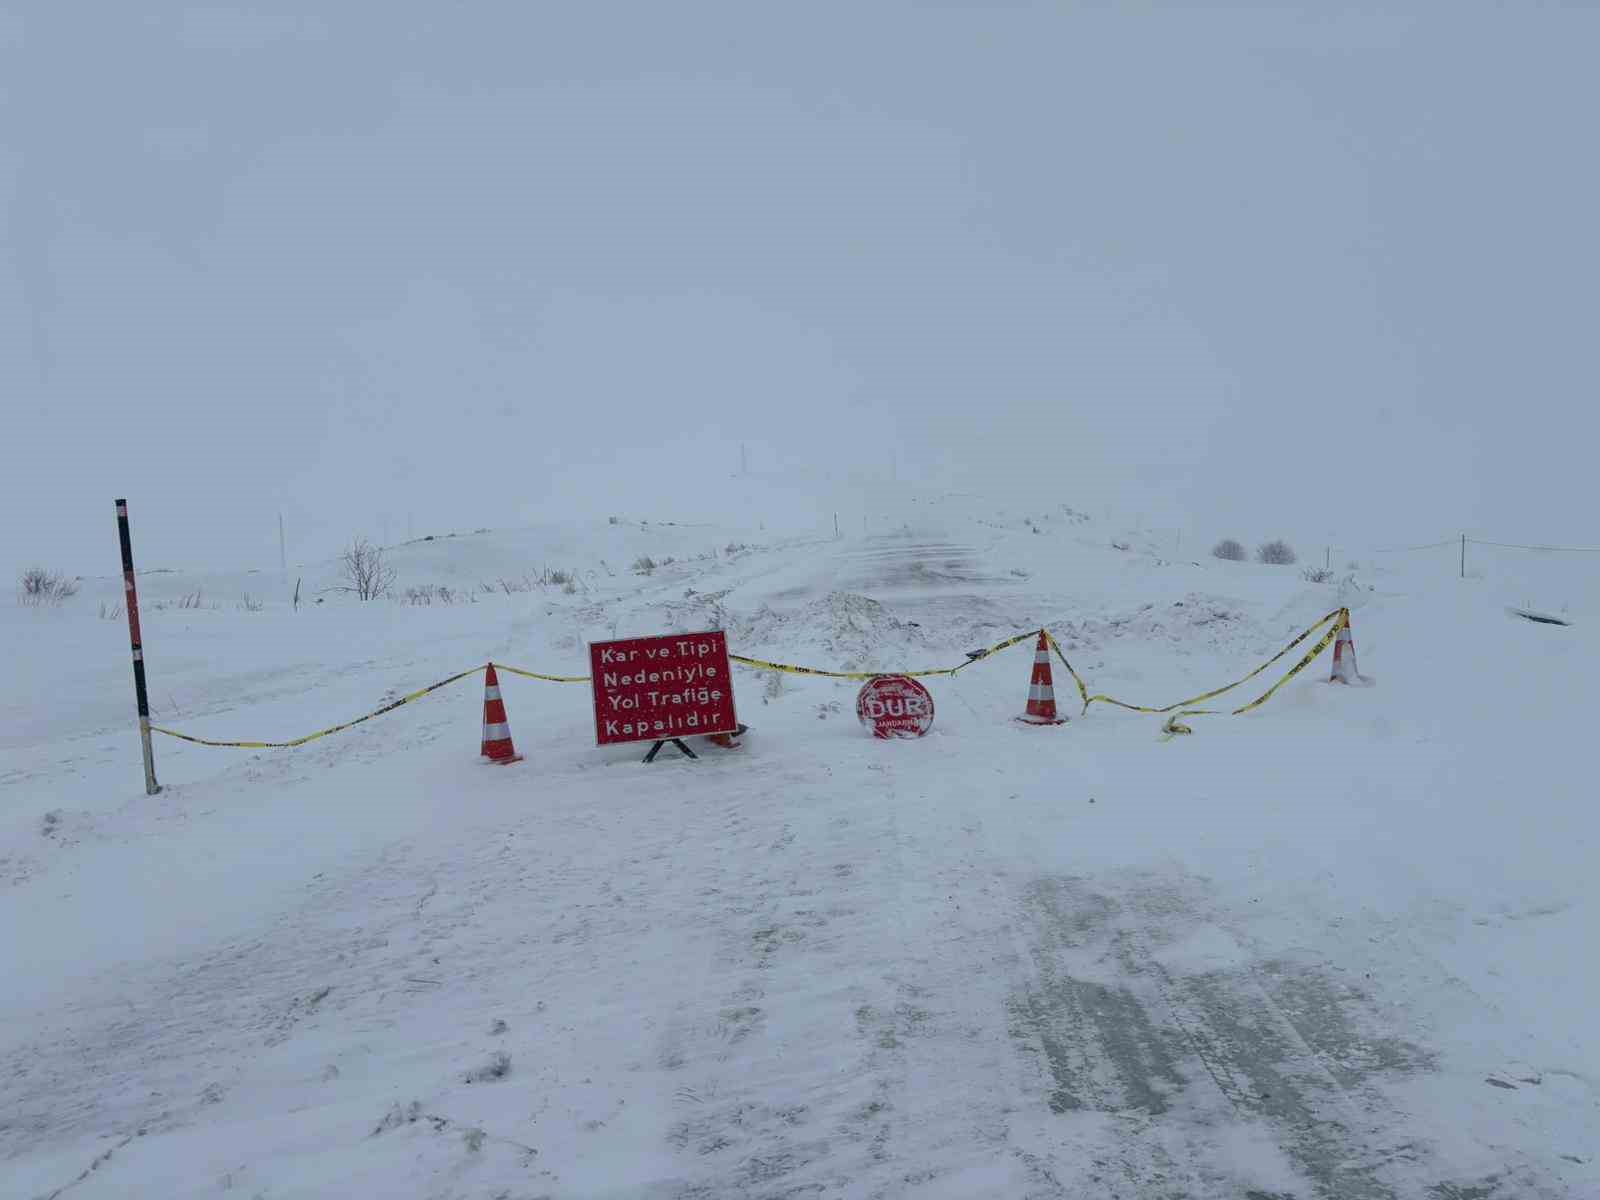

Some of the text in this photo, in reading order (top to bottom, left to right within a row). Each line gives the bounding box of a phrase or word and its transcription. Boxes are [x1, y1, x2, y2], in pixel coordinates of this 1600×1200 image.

[602, 640, 719, 663] Kar ve Tipi
[604, 664, 717, 687] Nedeniyle
[608, 687, 721, 711] Yol Trafiğe
[868, 698, 925, 718] DUR
[606, 712, 721, 736] Kapalıdır
